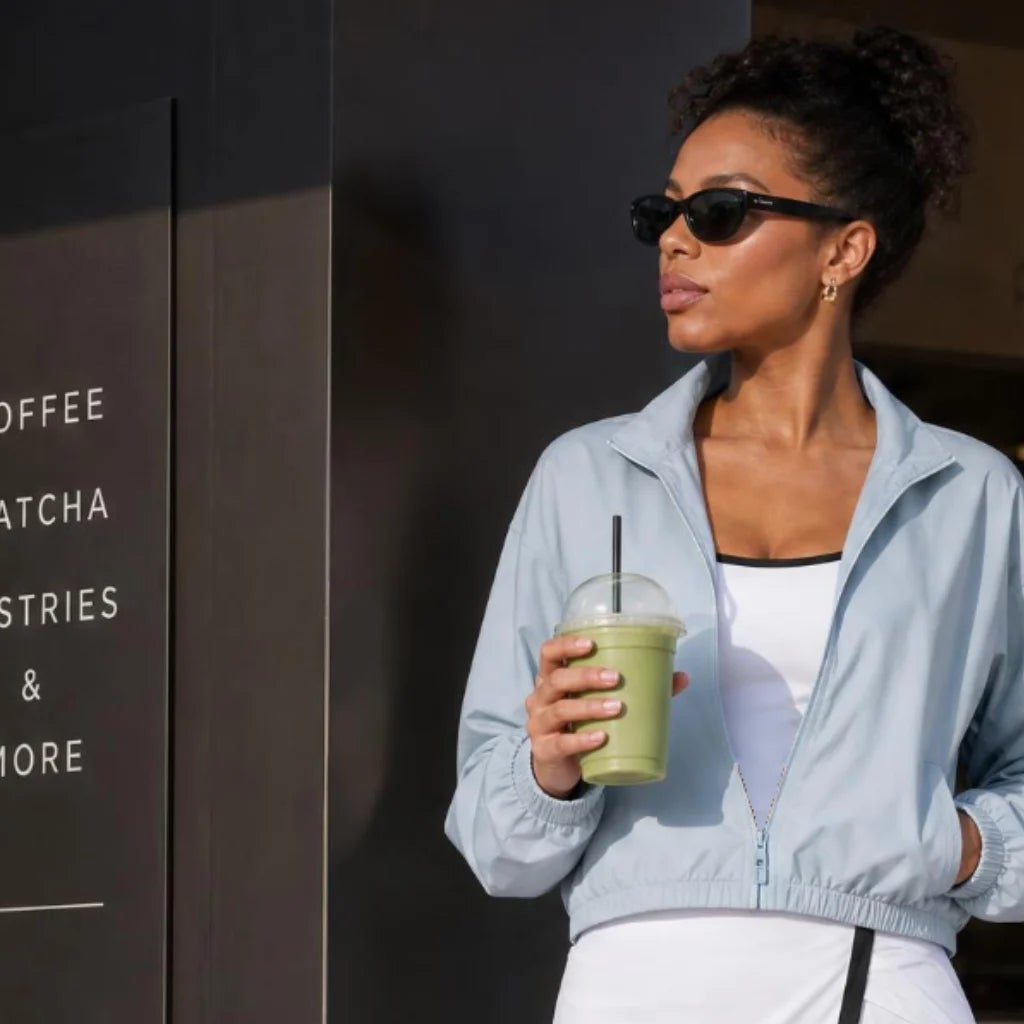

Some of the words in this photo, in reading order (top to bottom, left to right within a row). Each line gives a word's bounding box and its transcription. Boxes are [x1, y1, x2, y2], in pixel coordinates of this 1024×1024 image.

[0, 586, 117, 629] STRIES
[21, 669, 41, 701] &
[0, 739, 82, 777] ORE
